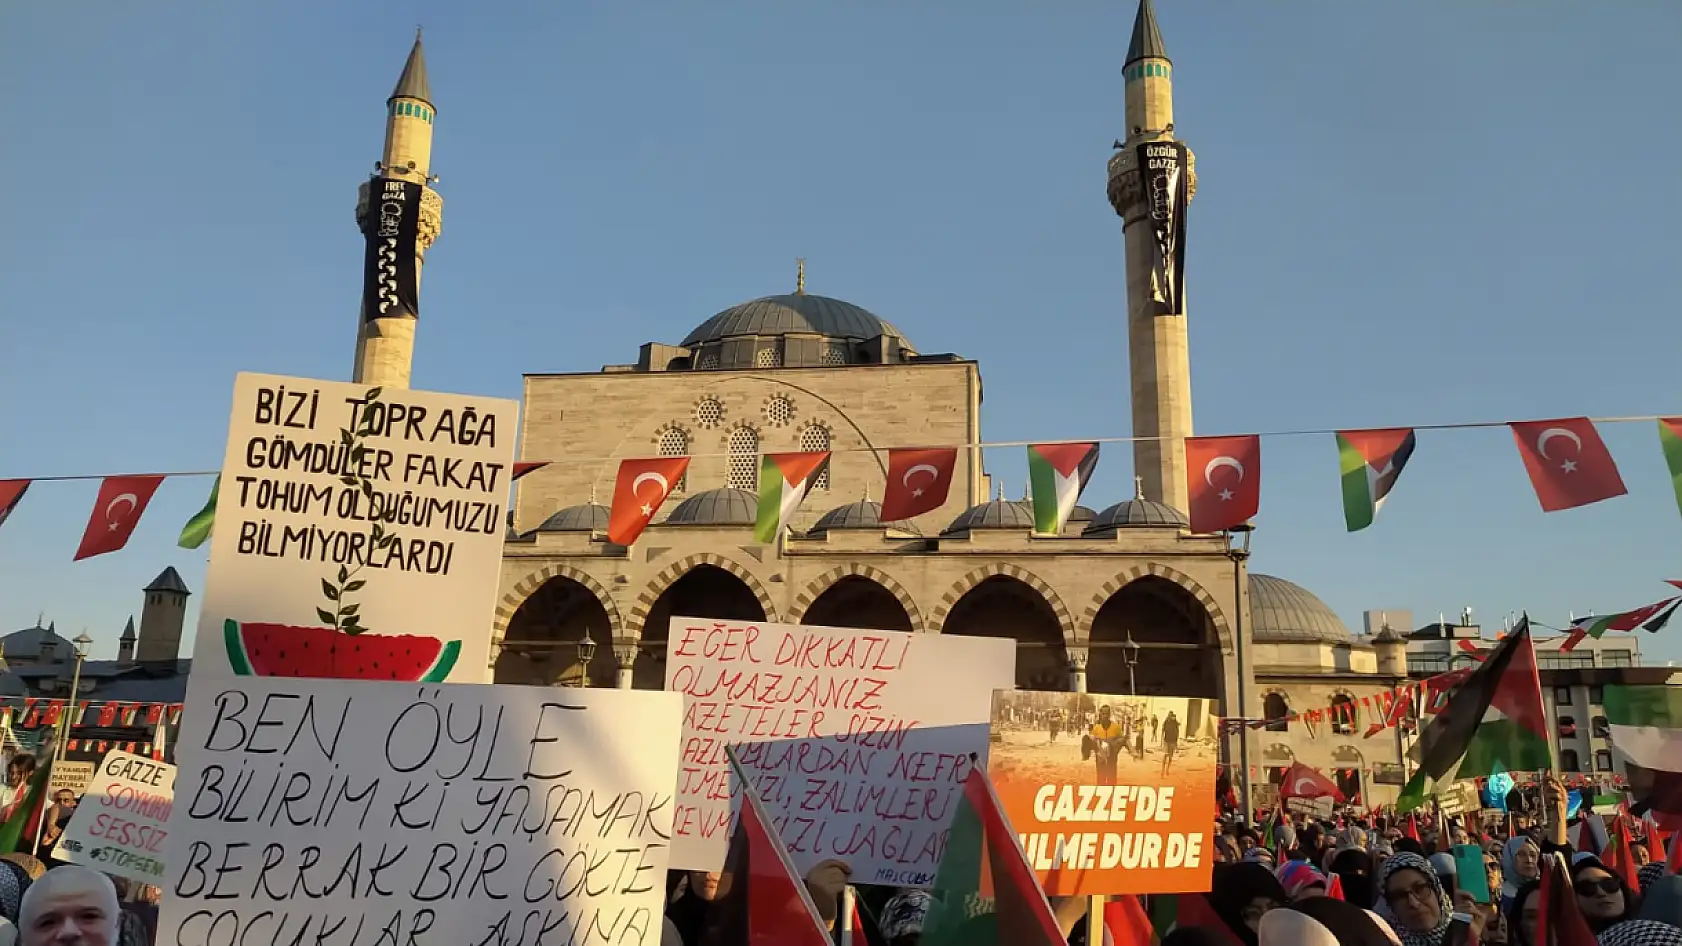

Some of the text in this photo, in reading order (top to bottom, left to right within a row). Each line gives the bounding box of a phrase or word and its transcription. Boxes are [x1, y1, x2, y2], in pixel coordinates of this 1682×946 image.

[1146, 145, 1178, 158] ÖZGÜR
[1149, 159, 1177, 169] GAZZE
[255, 386, 496, 447] BİZİ TOPRAĞA
[246, 435, 504, 492] GÖMDÜLER FAKAT
[236, 476, 499, 535] TOHUM OLDUĞUMUZU
[237, 519, 454, 575] BİLMİYORLARDI
[674, 623, 914, 671] EĞER DİKKATLİ
[204, 687, 587, 782] BEN ÖYLE
[682, 702, 825, 739] AZETELER
[106, 757, 167, 787] GAZZE
[887, 752, 973, 785] NEFR
[188, 759, 672, 843] BİLİRİM Kİ YAŞAMAK
[1033, 784, 1175, 822] GAZZE'DE
[174, 841, 667, 903] BERRAK BİR GÖKTE
[1018, 832, 1203, 870] ULME DUR DE
